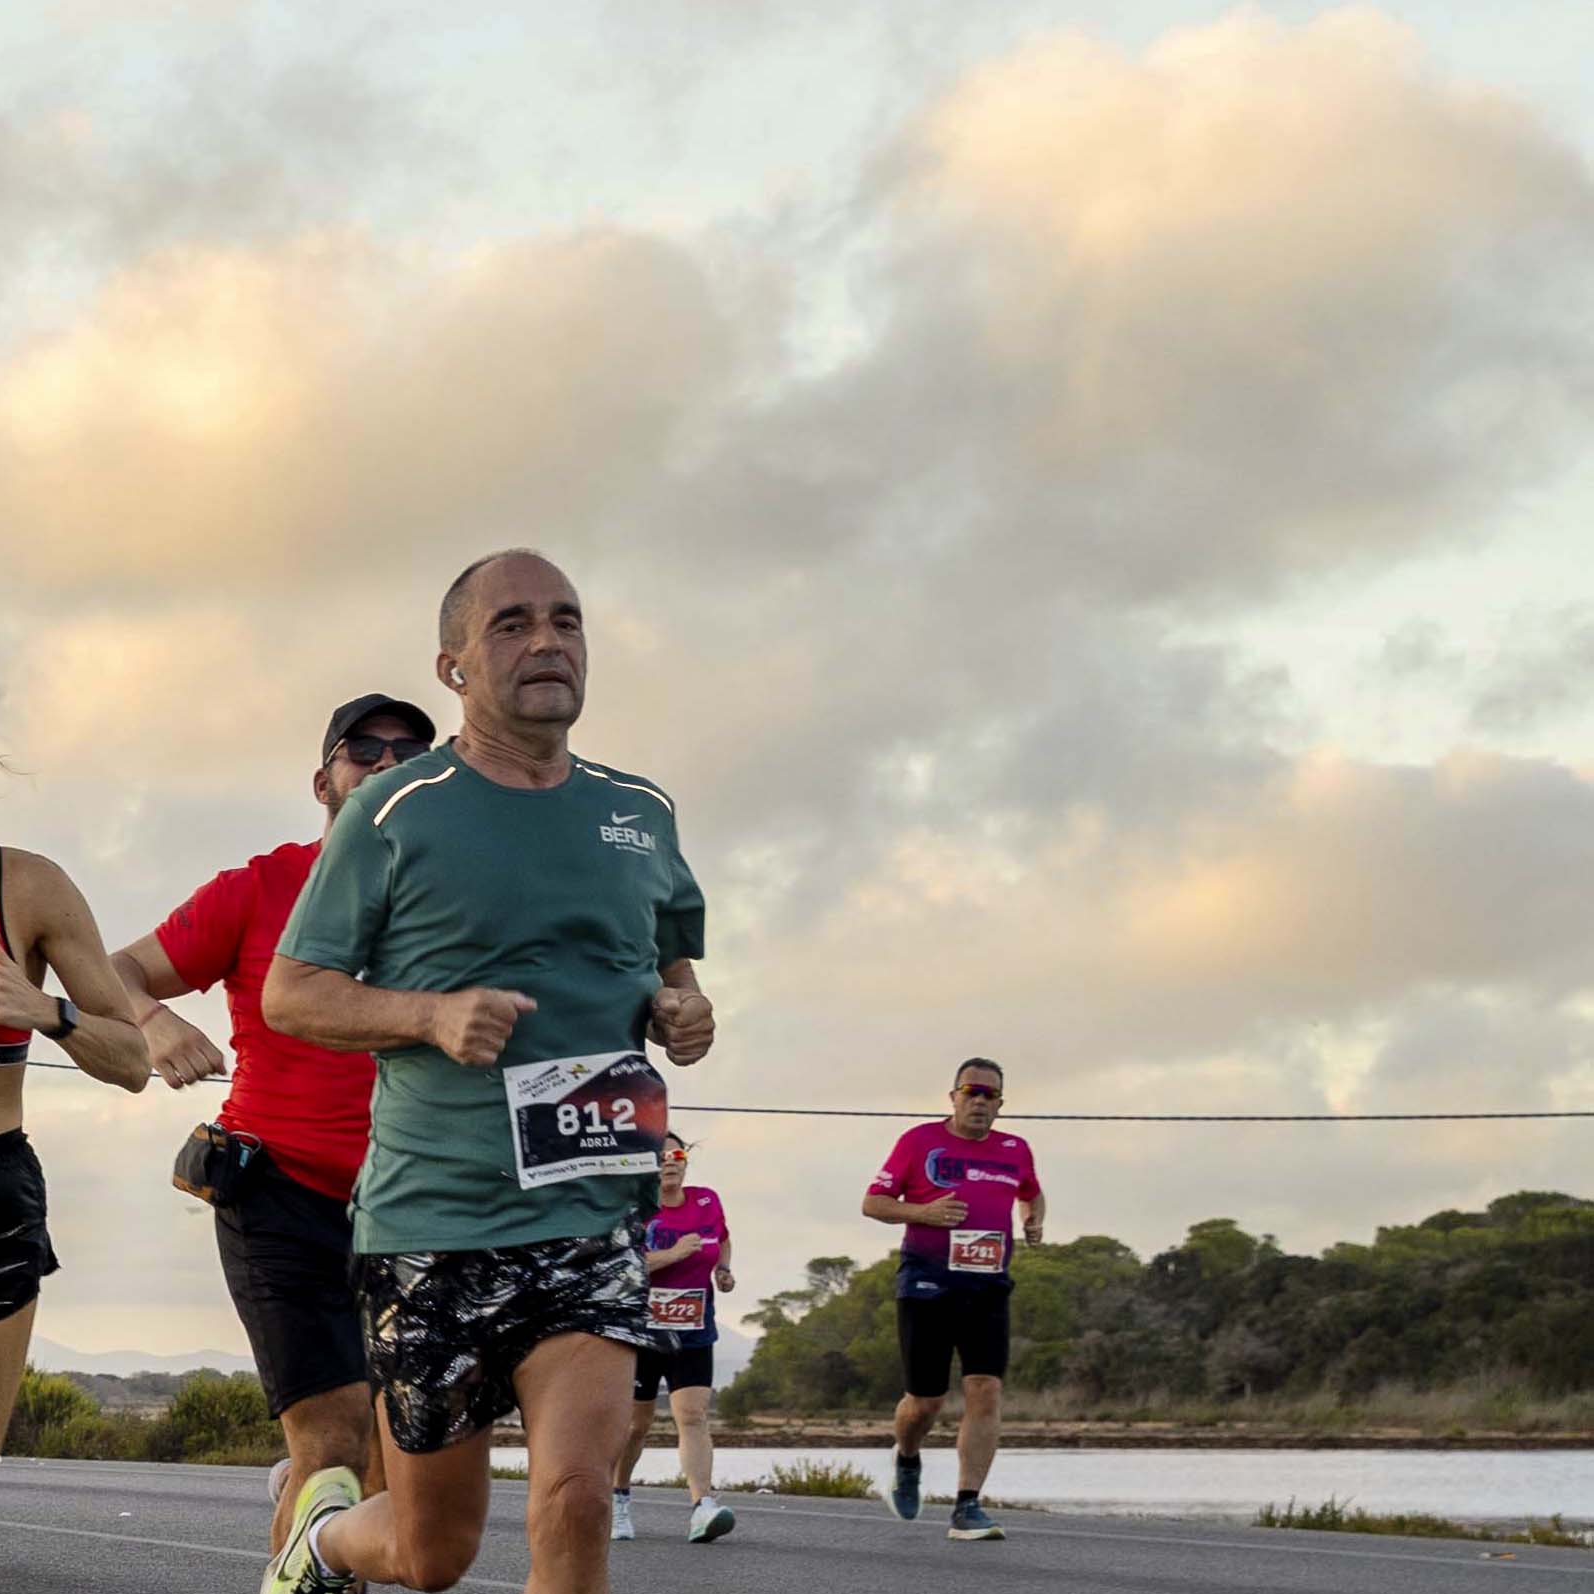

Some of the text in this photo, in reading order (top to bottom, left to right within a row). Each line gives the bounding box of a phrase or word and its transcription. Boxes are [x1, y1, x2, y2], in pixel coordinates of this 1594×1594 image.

[599, 825, 656, 850] BERLIN
[556, 1098, 637, 1136] 812
[579, 1133, 618, 1148] ADRIÀ
[658, 1303, 696, 1316] 1772
